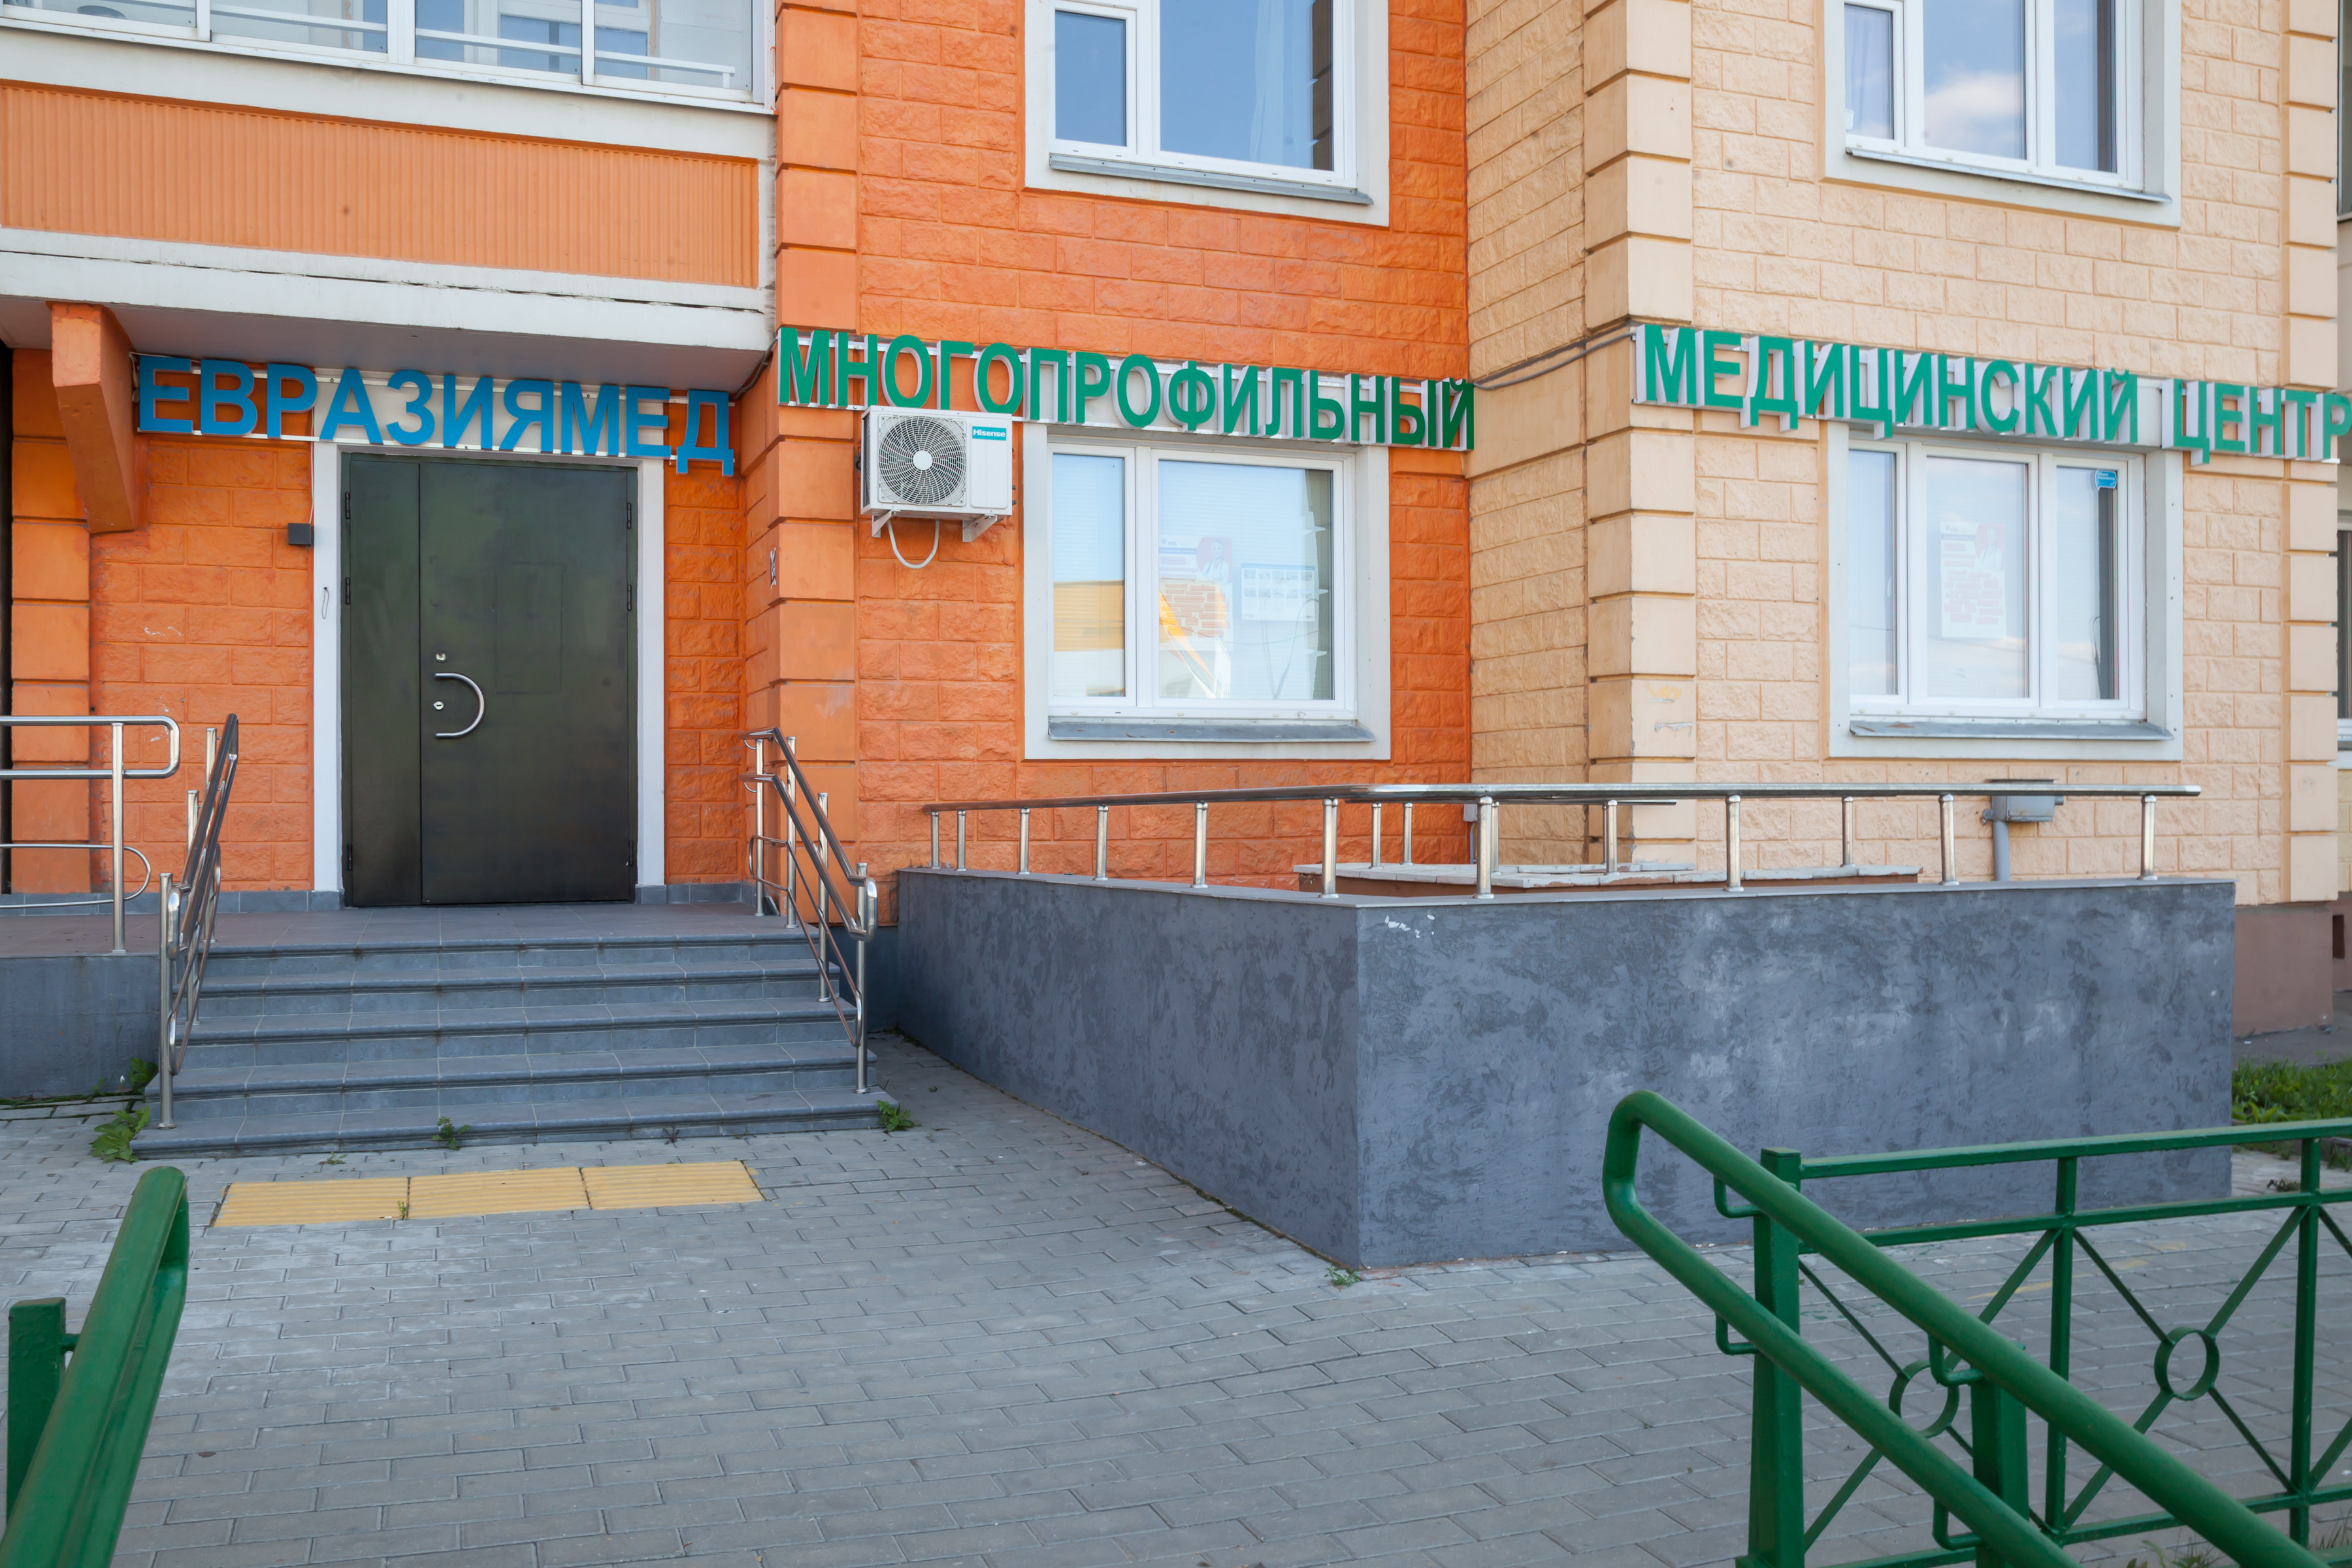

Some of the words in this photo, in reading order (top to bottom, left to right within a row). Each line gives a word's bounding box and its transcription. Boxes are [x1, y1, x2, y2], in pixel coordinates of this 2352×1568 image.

[139, 355, 734, 476] ЕВРАЗИЯМЕД
[779, 327, 1475, 451] МНОГОПРОФИЛЬНЫЙ
[973, 429, 1006, 438] Hisense
[1642, 324, 2138, 444] МЕДИЦИНСКИЙ
[2172, 379, 2352, 464] ЦЕНТР
